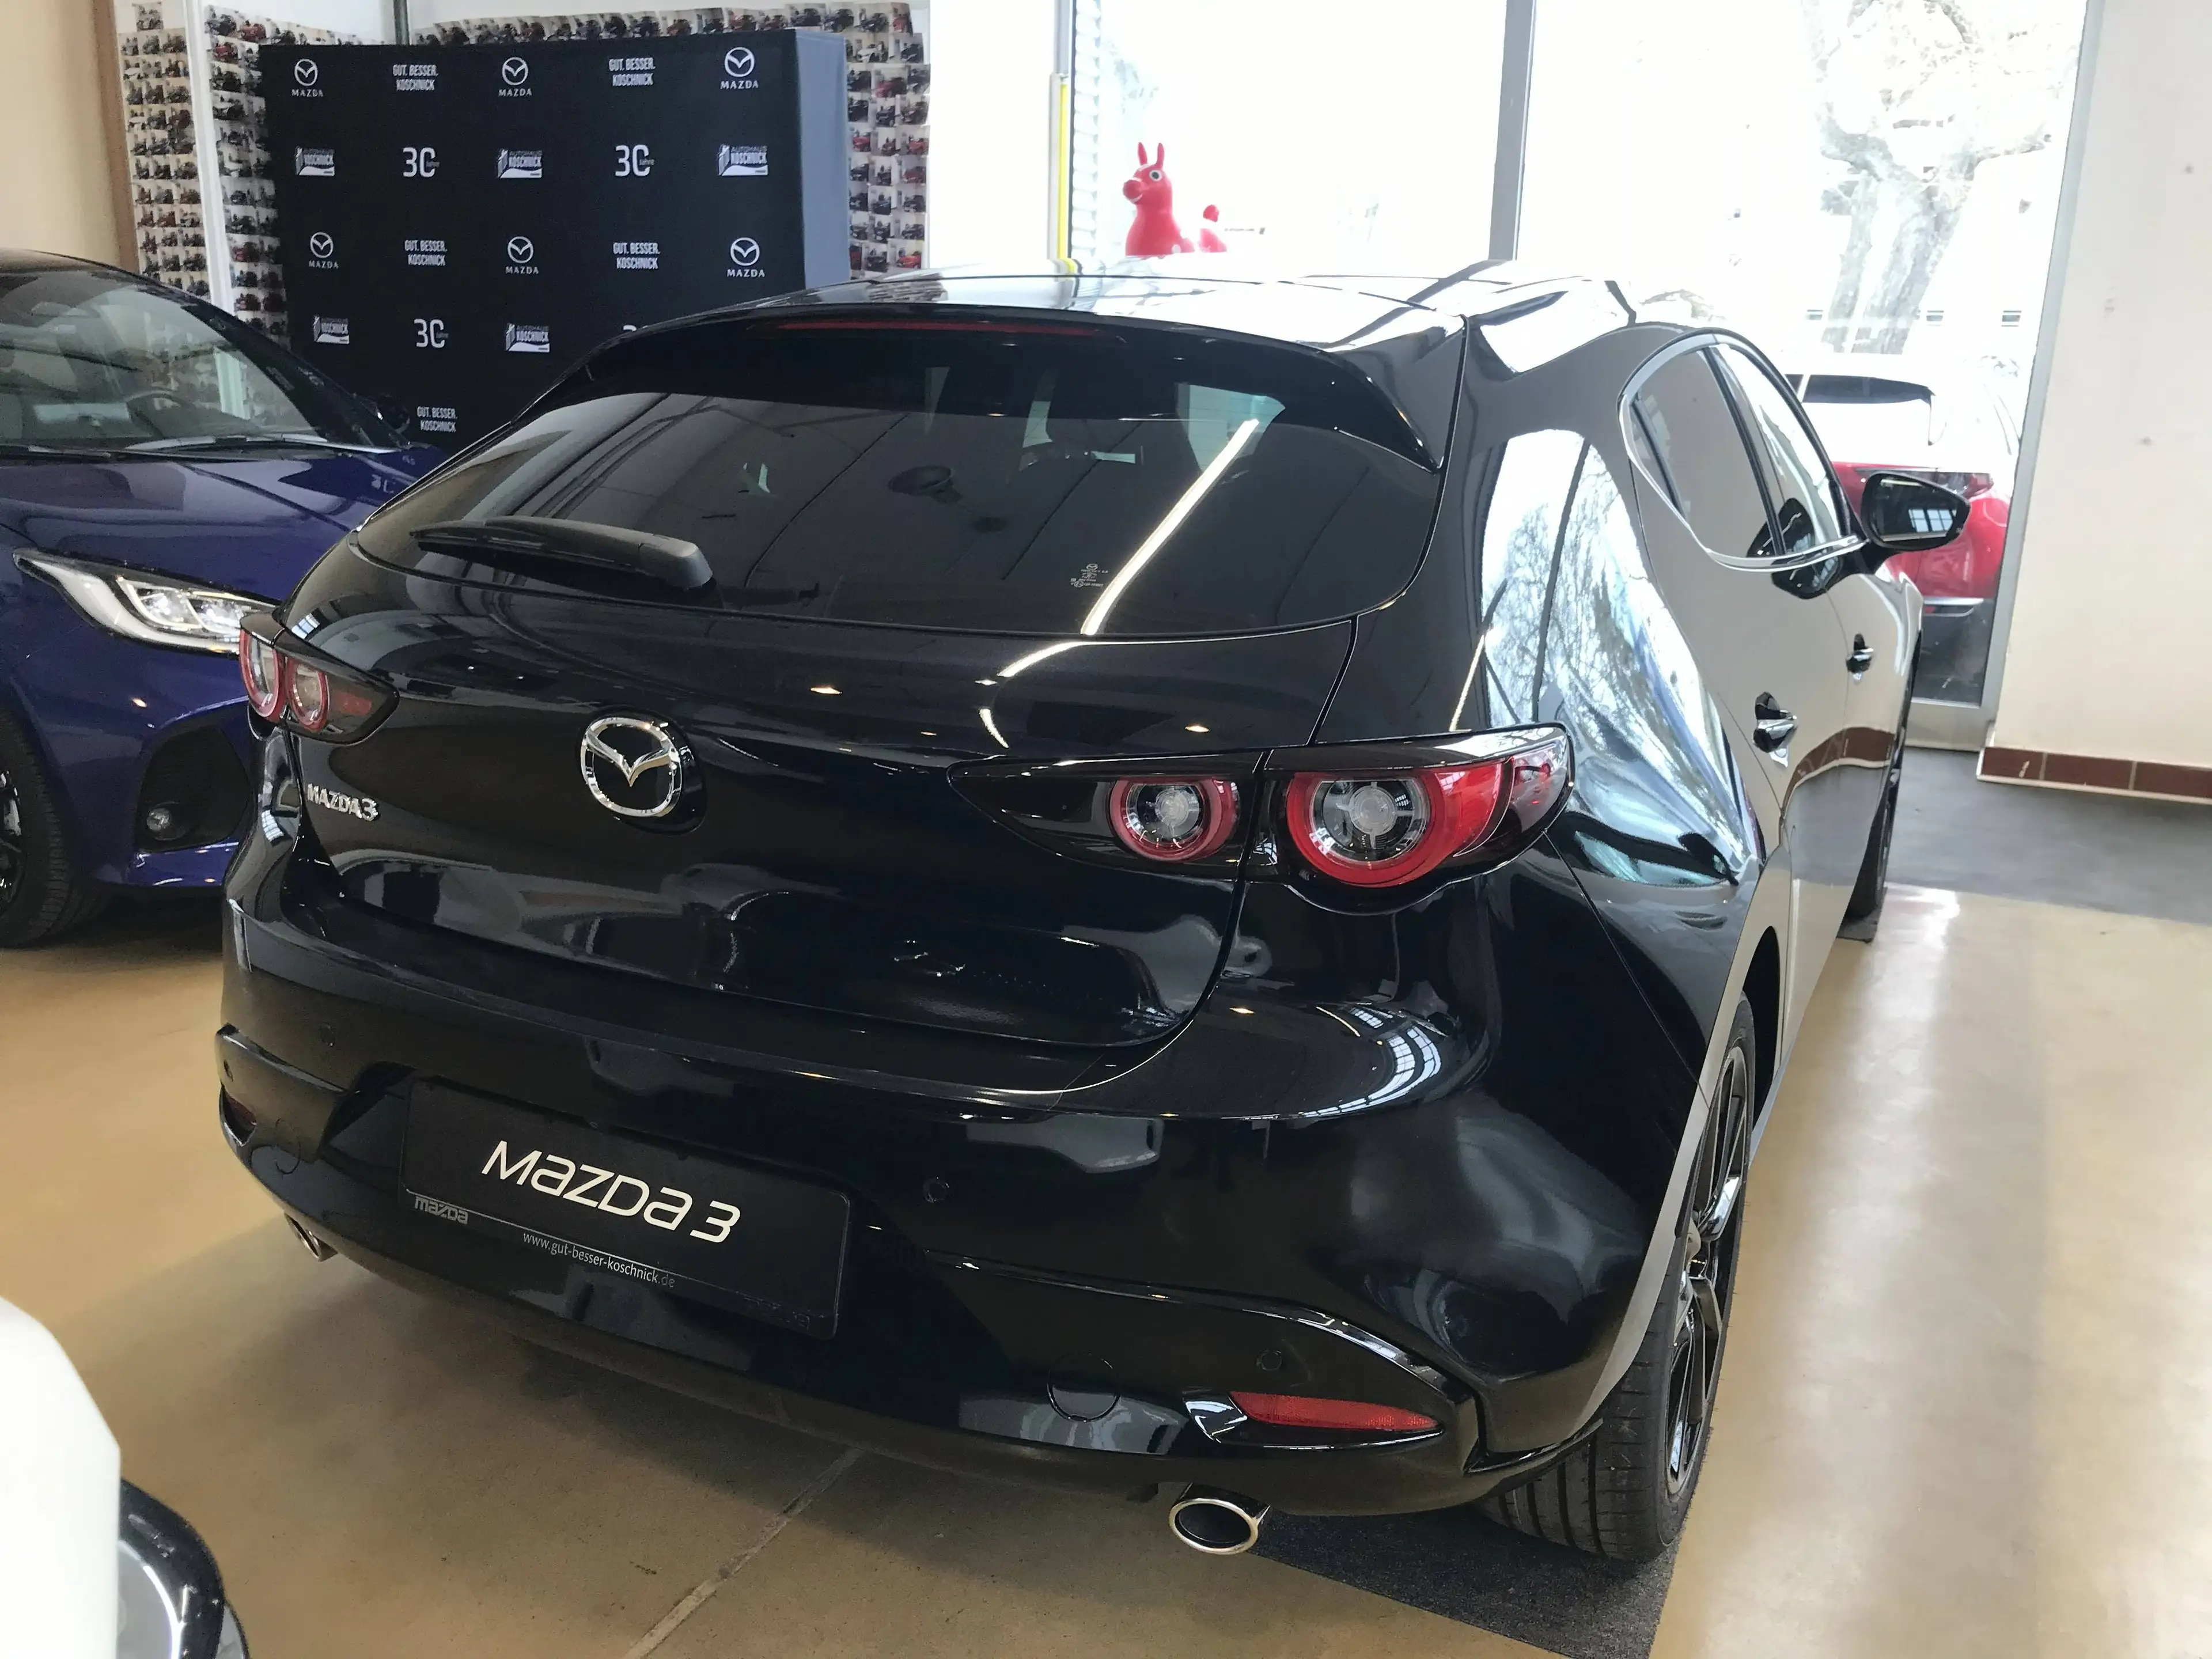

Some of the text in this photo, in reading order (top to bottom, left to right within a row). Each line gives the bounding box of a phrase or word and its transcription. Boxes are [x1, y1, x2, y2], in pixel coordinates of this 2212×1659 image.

[392, 64, 439, 76] GUT. BESSER.
[609, 58, 656, 71] GUT. BESSER.
[612, 73, 653, 86] KOSCHNICK
[720, 79, 759, 90] MAZDA
[291, 89, 323, 97] MAZDA
[498, 88, 532, 97] MAZDA
[404, 240, 448, 252] GUT. BESSER.
[613, 242, 661, 255] GUT. BESSER.
[308, 260, 339, 269] MAZDA
[408, 254, 446, 266] KOSCHNICK
[616, 257, 659, 270] KOSCHNICK
[505, 266, 539, 275] MAZDA
[727, 268, 766, 278] MAZDA
[416, 406, 459, 420] GUT. BESSER.
[307, 783, 379, 821] MAZDA3
[689, 1200, 741, 1244] 3
[523, 1232, 675, 1288] www.gut-besser-koschnick.de
